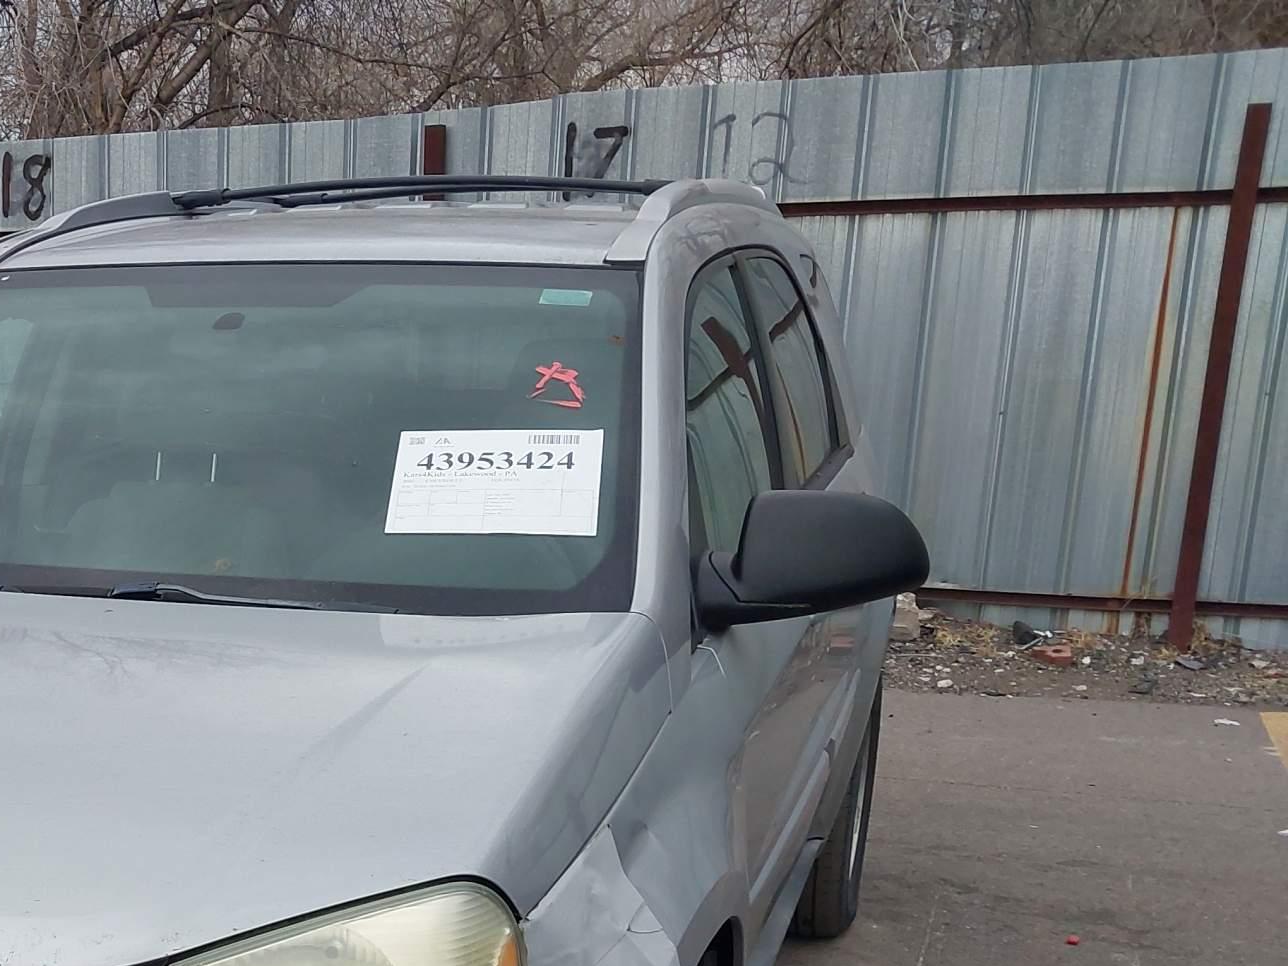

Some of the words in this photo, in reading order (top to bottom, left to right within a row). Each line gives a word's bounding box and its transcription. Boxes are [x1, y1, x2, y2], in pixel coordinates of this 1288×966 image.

[563, 121, 629, 201] 17
[713, 112, 811, 187] 12
[1, 151, 52, 221] 18
[416, 451, 576, 471] 43953424
